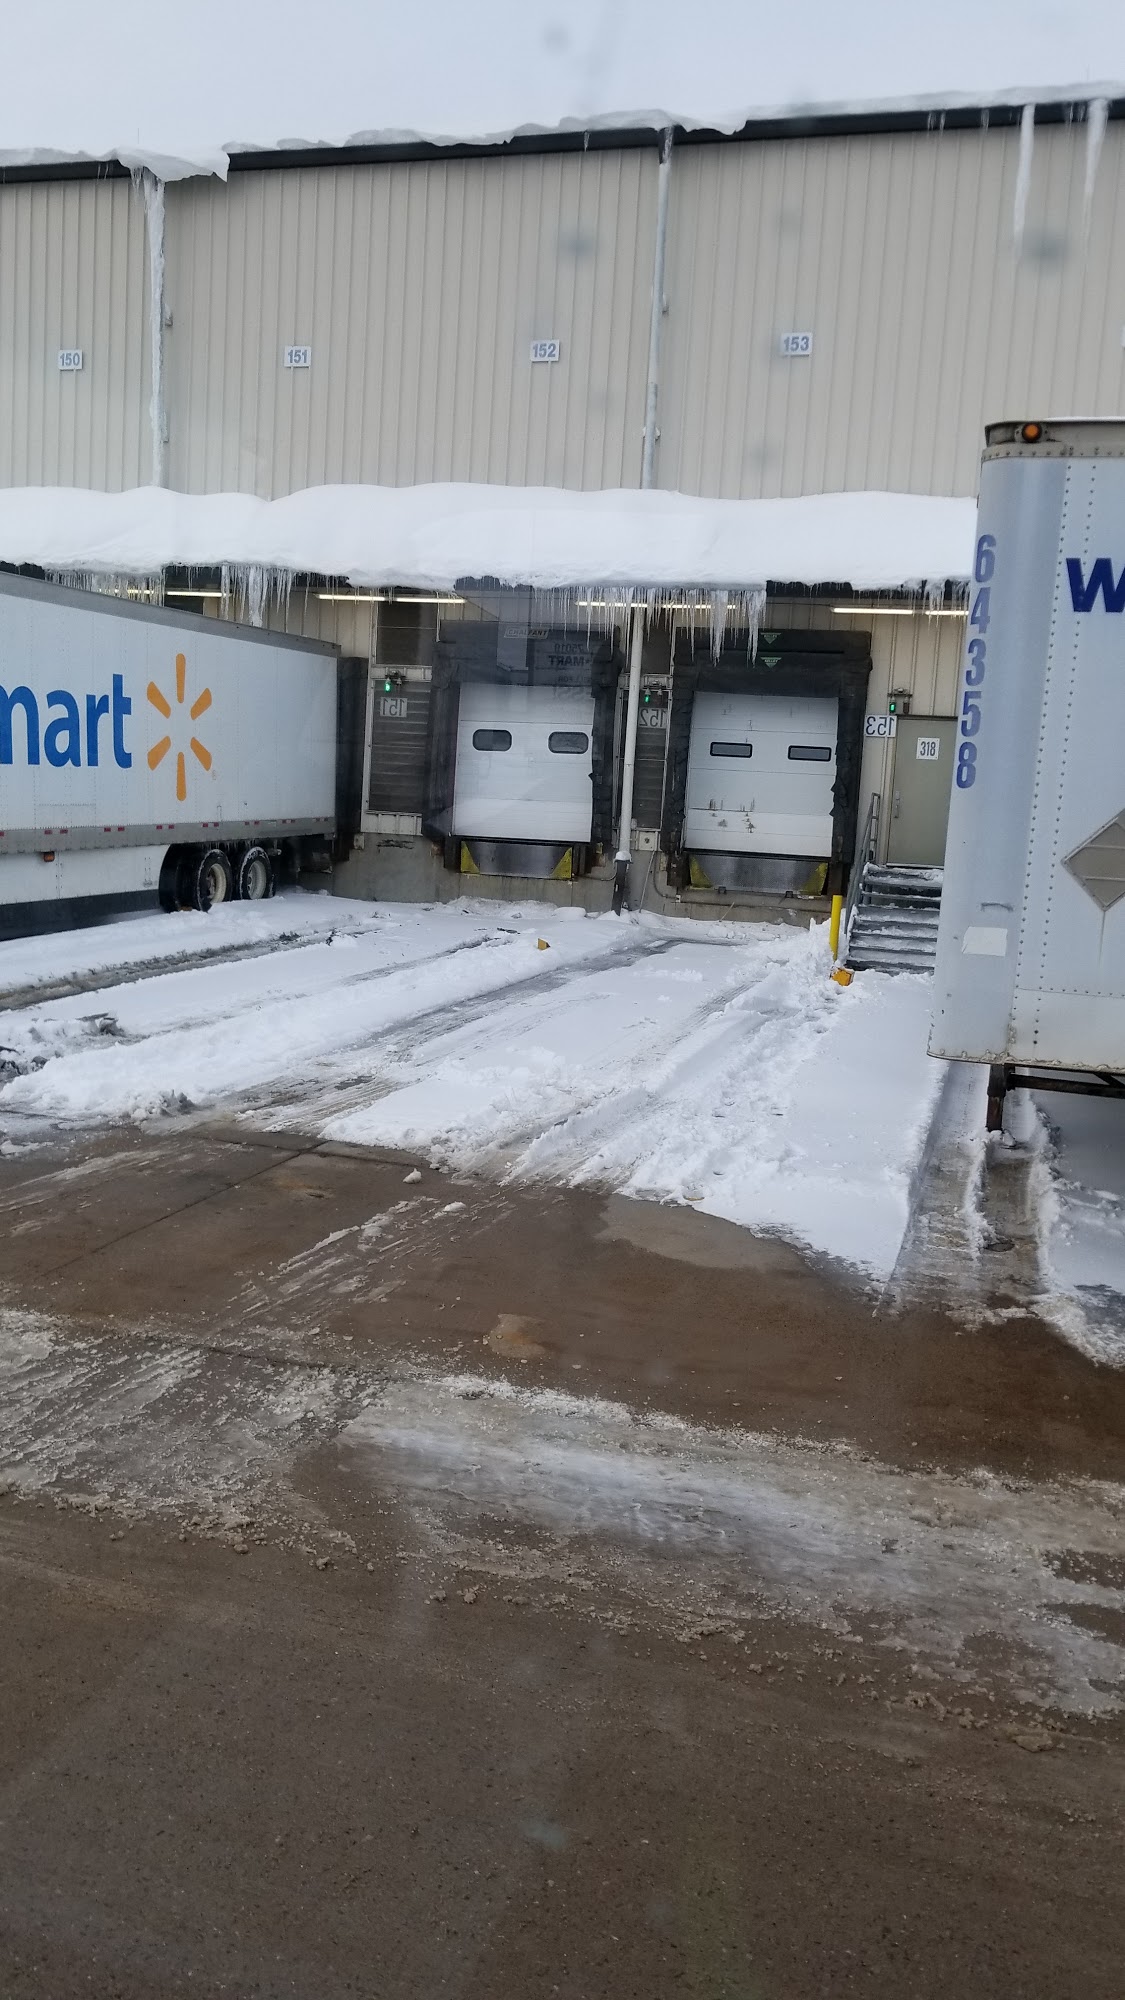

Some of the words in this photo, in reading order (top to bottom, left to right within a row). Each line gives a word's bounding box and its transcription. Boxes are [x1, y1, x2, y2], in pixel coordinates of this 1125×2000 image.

[533, 343, 557, 358] 152
[784, 336, 810, 352] 153
[60, 352, 80, 366] 150
[288, 349, 307, 364] 151
[956, 534, 997, 789] 64358
[919, 741, 936, 757] 318
